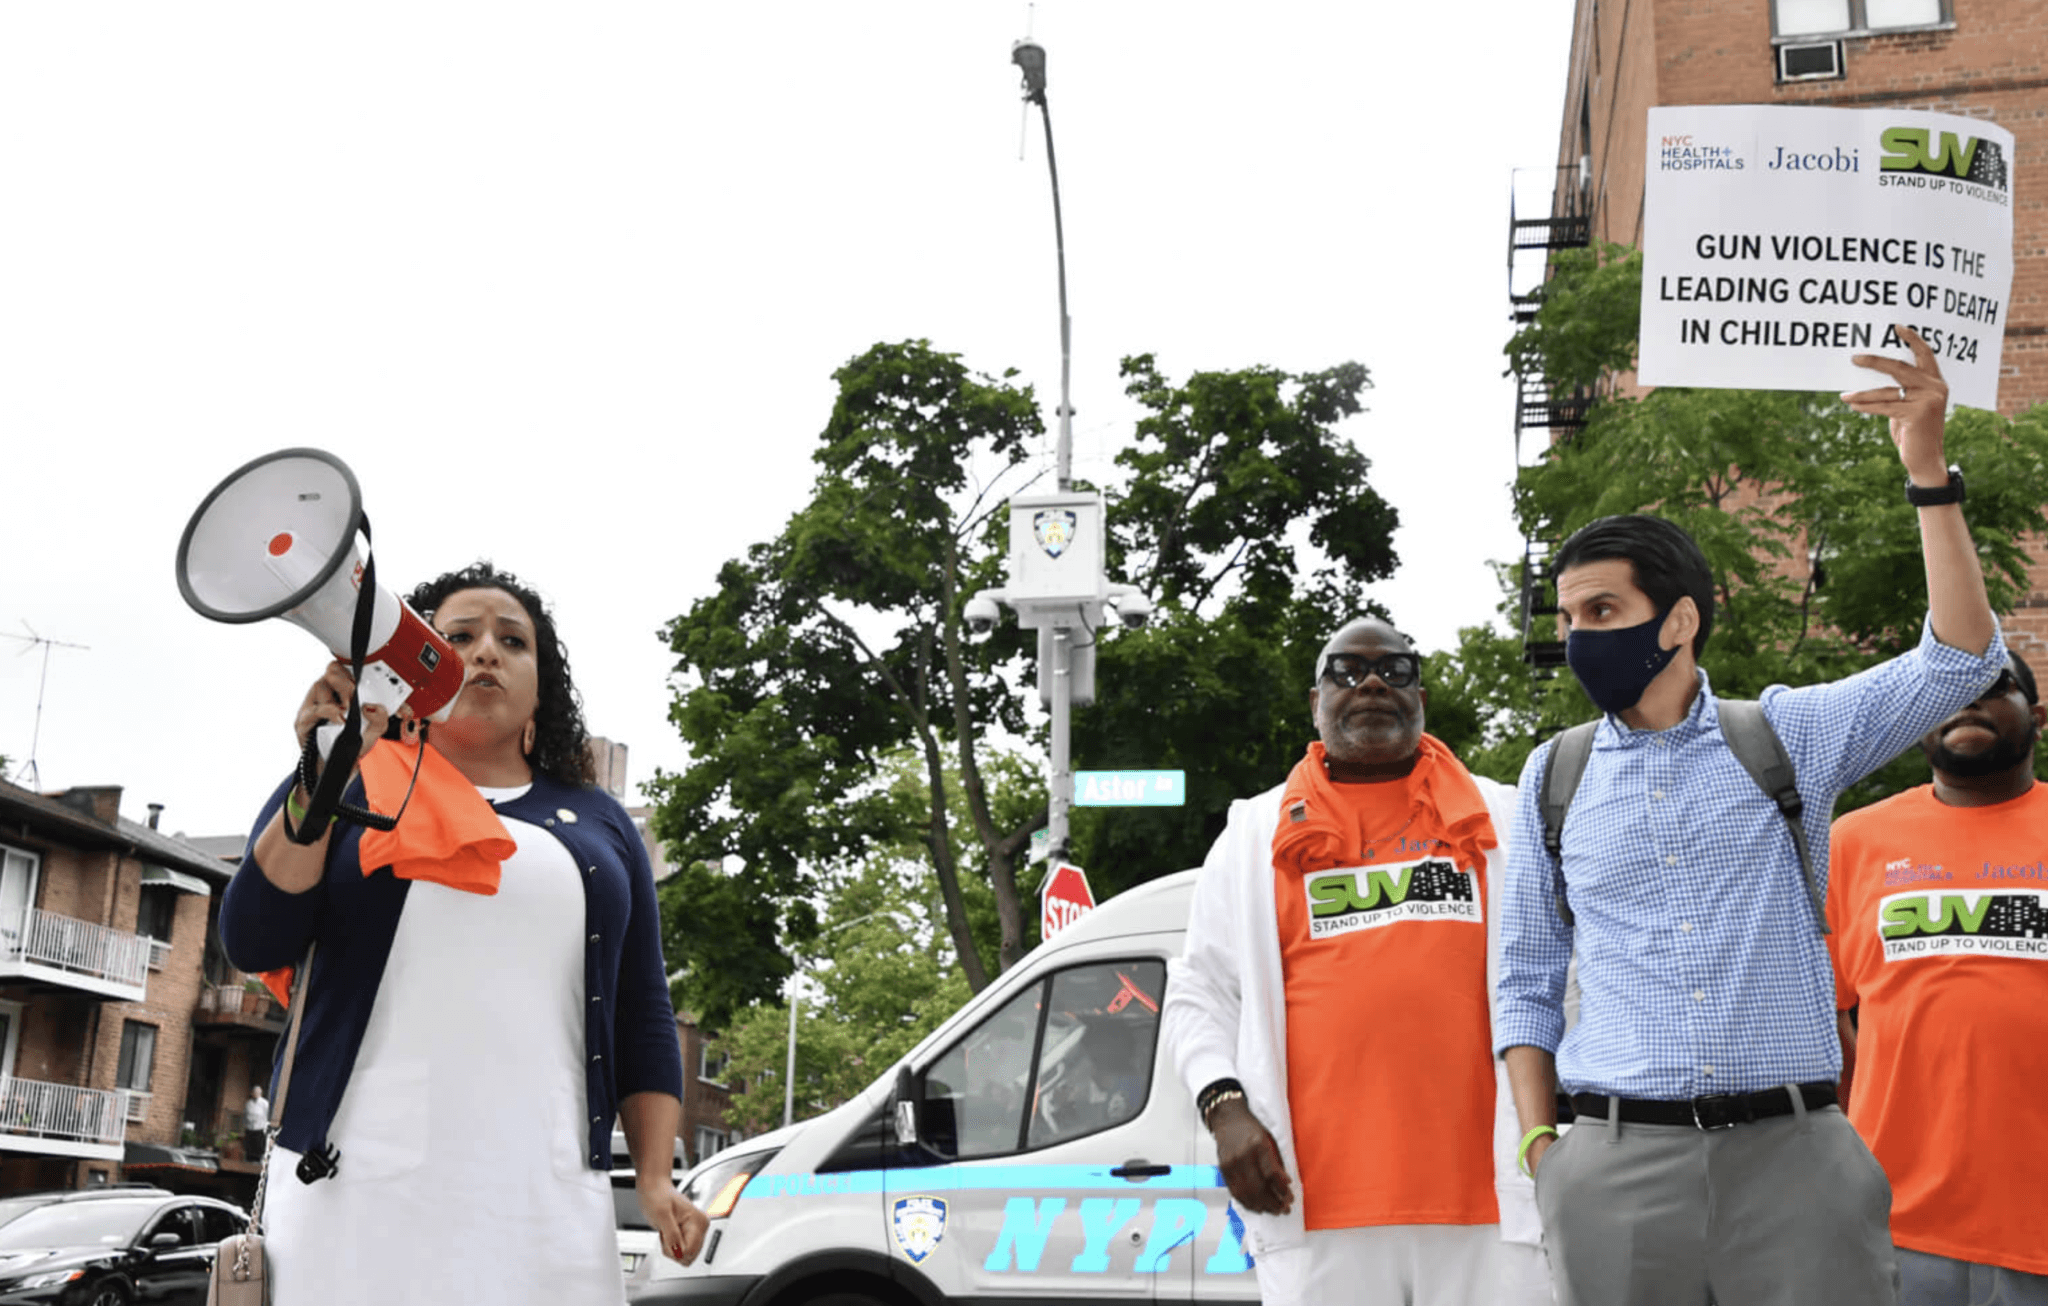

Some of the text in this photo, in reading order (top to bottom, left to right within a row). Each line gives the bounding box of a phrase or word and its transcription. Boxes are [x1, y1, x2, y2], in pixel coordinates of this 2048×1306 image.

[1661, 135, 1693, 147] NYC
[1879, 127, 1978, 177] SUV
[1661, 158, 1744, 171] HOSPITALS
[1768, 146, 1860, 173] Jacobi
[1879, 175, 1926, 188] STAND
[1929, 178, 1946, 190] UP
[1950, 181, 1963, 195] TO
[1696, 234, 1986, 279] GUN VIOLENCE IS THE
[1660, 275, 1999, 325] LEADING CAUSE OF DEATH
[1681, 318, 1710, 344] IN
[1720, 319, 1872, 348] CHILDREN
[1946, 333, 1978, 364] 1-24
[1082, 774, 1148, 802] Astor
[1308, 866, 1414, 916] SUV
[1046, 896, 1091, 938] STO
[1313, 903, 1476, 932] STAND UP TO VIOLENCE
[1881, 895, 1993, 938] SUV
[1930, 938, 1950, 950] UP
[1954, 938, 1975, 949] TO
[772, 1172, 850, 1198] POLICE
